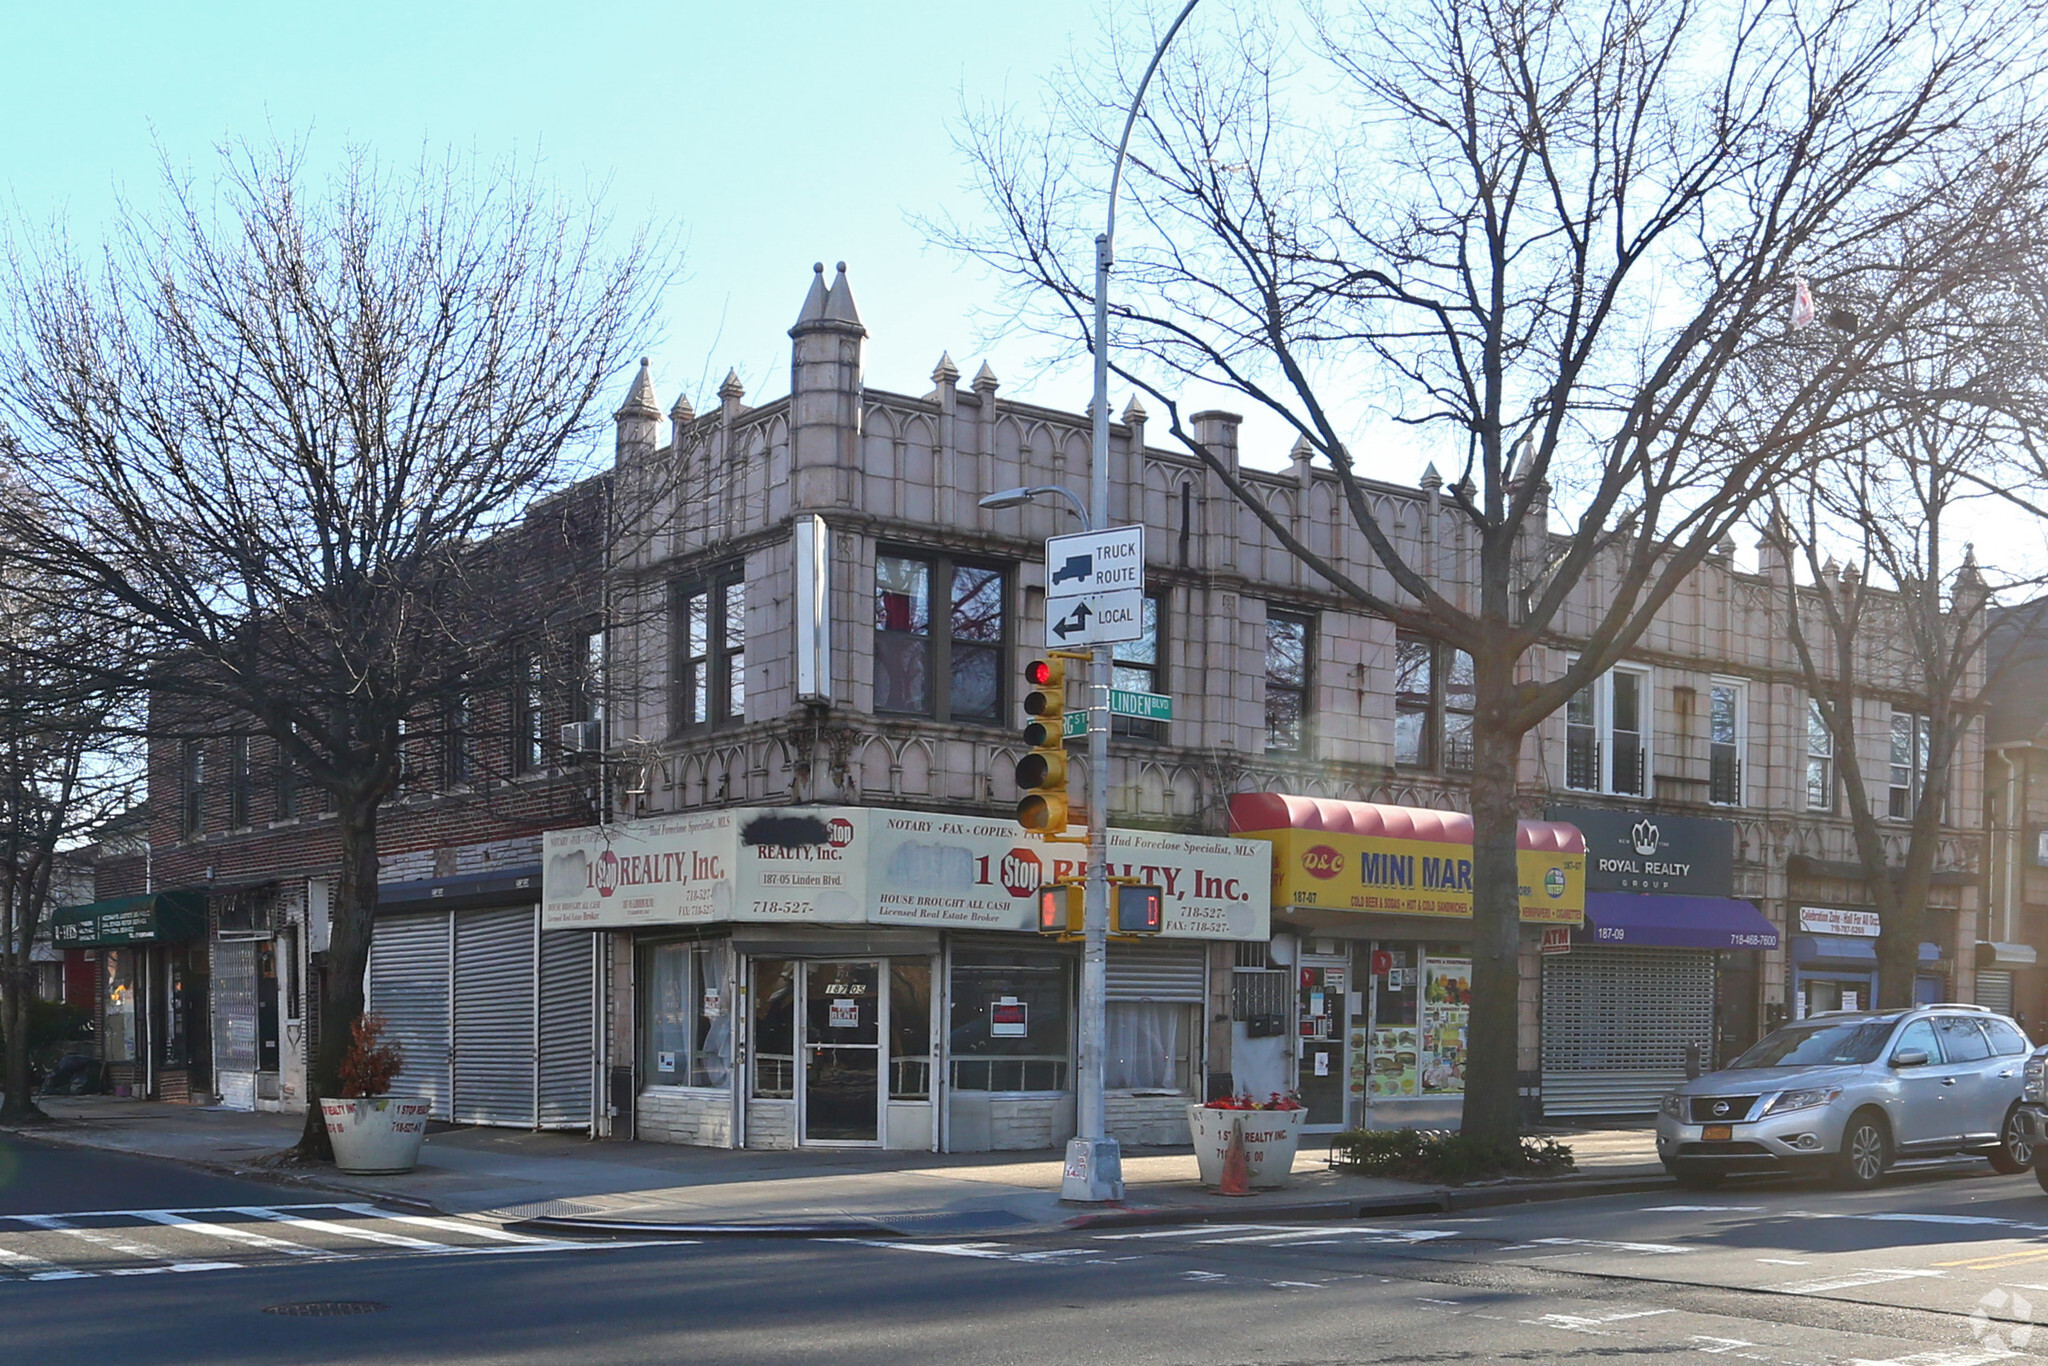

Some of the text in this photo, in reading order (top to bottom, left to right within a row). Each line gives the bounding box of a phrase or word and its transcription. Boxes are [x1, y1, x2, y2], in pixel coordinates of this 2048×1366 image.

[1096, 543, 1135, 560] TRUCK
[1096, 567, 1135, 584] ROUTE
[1098, 609, 1133, 624] LOCAL
[1111, 692, 1169, 715] LINDEN BLVD
[1075, 714, 1086, 724] ST
[827, 823, 851, 843] Stop
[886, 819, 933, 832] NOTARY
[758, 845, 842, 861] REALTY, Inc.
[1110, 835, 1255, 856] Hud Foreclose Specialist, MLS
[586, 861, 594, 888] 1
[620, 852, 687, 886] REALTY,
[692, 851, 724, 880] Inc.
[1302, 852, 1344, 872] D&C
[1599, 859, 1690, 877] ROYAL REALTY
[763, 874, 841, 886] 187-05 Linden Blvd.
[974, 855, 994, 885] 1
[1004, 855, 1038, 891] Stop
[1194, 869, 1249, 901] Inc.
[1361, 852, 1474, 894] MINI MAR
[1622, 879, 1669, 889] GROUP
[880, 894, 1011, 911] HOUSE BROUGHT ALL CASH
[1293, 891, 1317, 904] 187-07
[1351, 896, 1364, 907] COLD
[1365, 897, 1378, 908] BEER
[1384, 898, 1400, 909] SODAS
[1406, 899, 1416, 910] HOT
[1422, 900, 1435, 911] COLD
[753, 901, 814, 913] 718-527-
[879, 906, 999, 922] Licensed Real Estate Broker
[1180, 906, 1226, 919] 718-527-
[1166, 920, 1187, 931] FAX:
[1544, 929, 1569, 945] ATM
[1598, 928, 1625, 940] 187-09
[827, 985, 866, 994] 187 05
[832, 1012, 857, 1020] RENT
[402, 1105, 416, 1114] STOP
[1217, 1130, 1221, 1140] 1
[1244, 1131, 1273, 1143] REALTY
